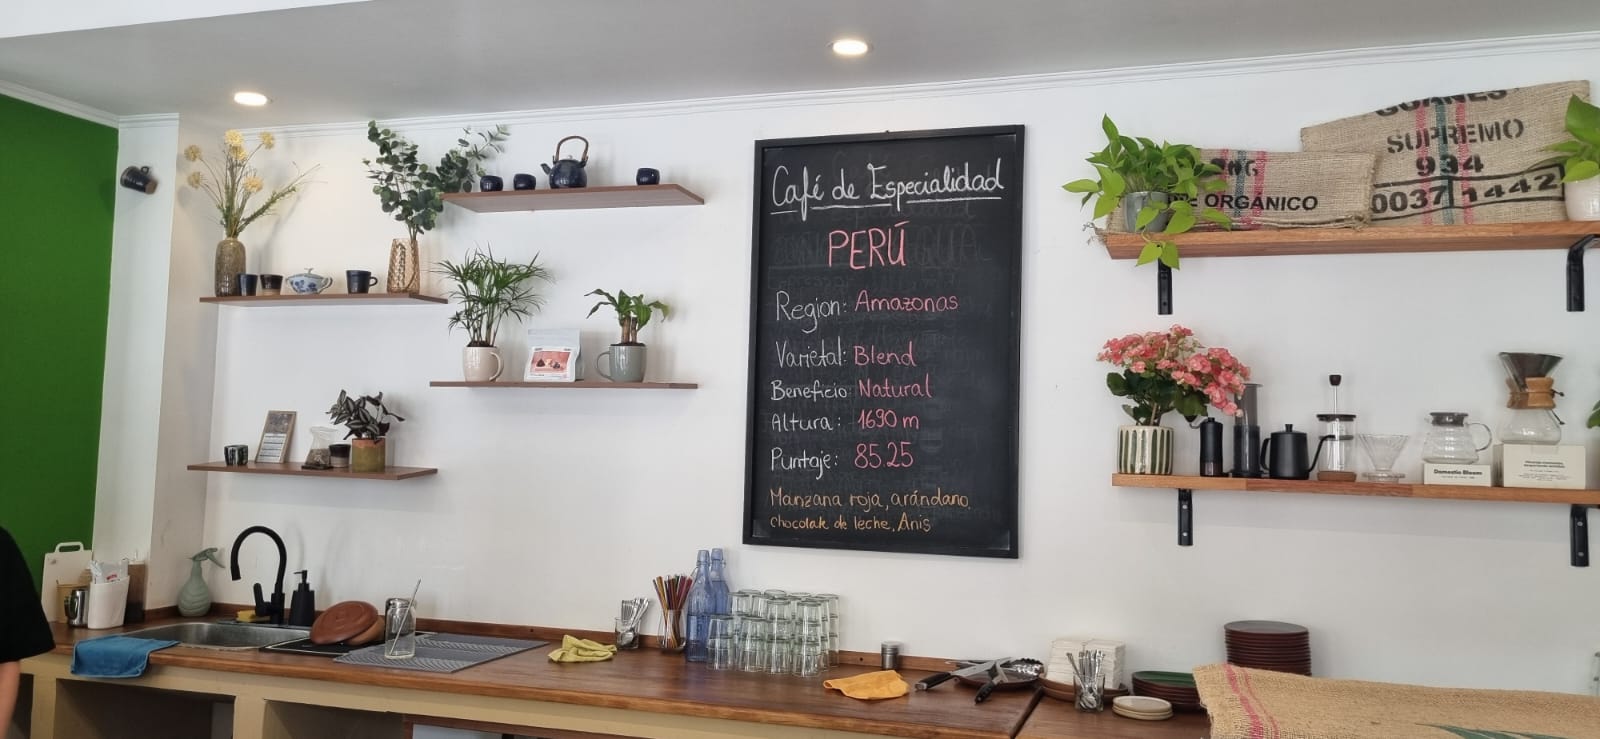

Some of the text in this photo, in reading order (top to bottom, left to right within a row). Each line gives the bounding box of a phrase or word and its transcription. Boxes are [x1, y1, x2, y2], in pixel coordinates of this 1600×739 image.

[1387, 118, 1524, 153] SUPREMO
[1416, 154, 1484, 176] 934
[772, 157, 1005, 221] Café de Especialidad
[1204, 192, 1318, 211] ORGÁNICO
[1371, 174, 1558, 214] 0037 1442
[828, 220, 910, 270] PERÚ
[854, 290, 959, 313] Amazonas
[853, 341, 917, 367] Blend
[858, 373, 933, 399] Natural
[857, 408, 898, 430] 1690
[902, 414, 920, 430] m
[854, 441, 914, 469] 85.25
[770, 487, 842, 508] Manzana
[833, 514, 848, 530] de
